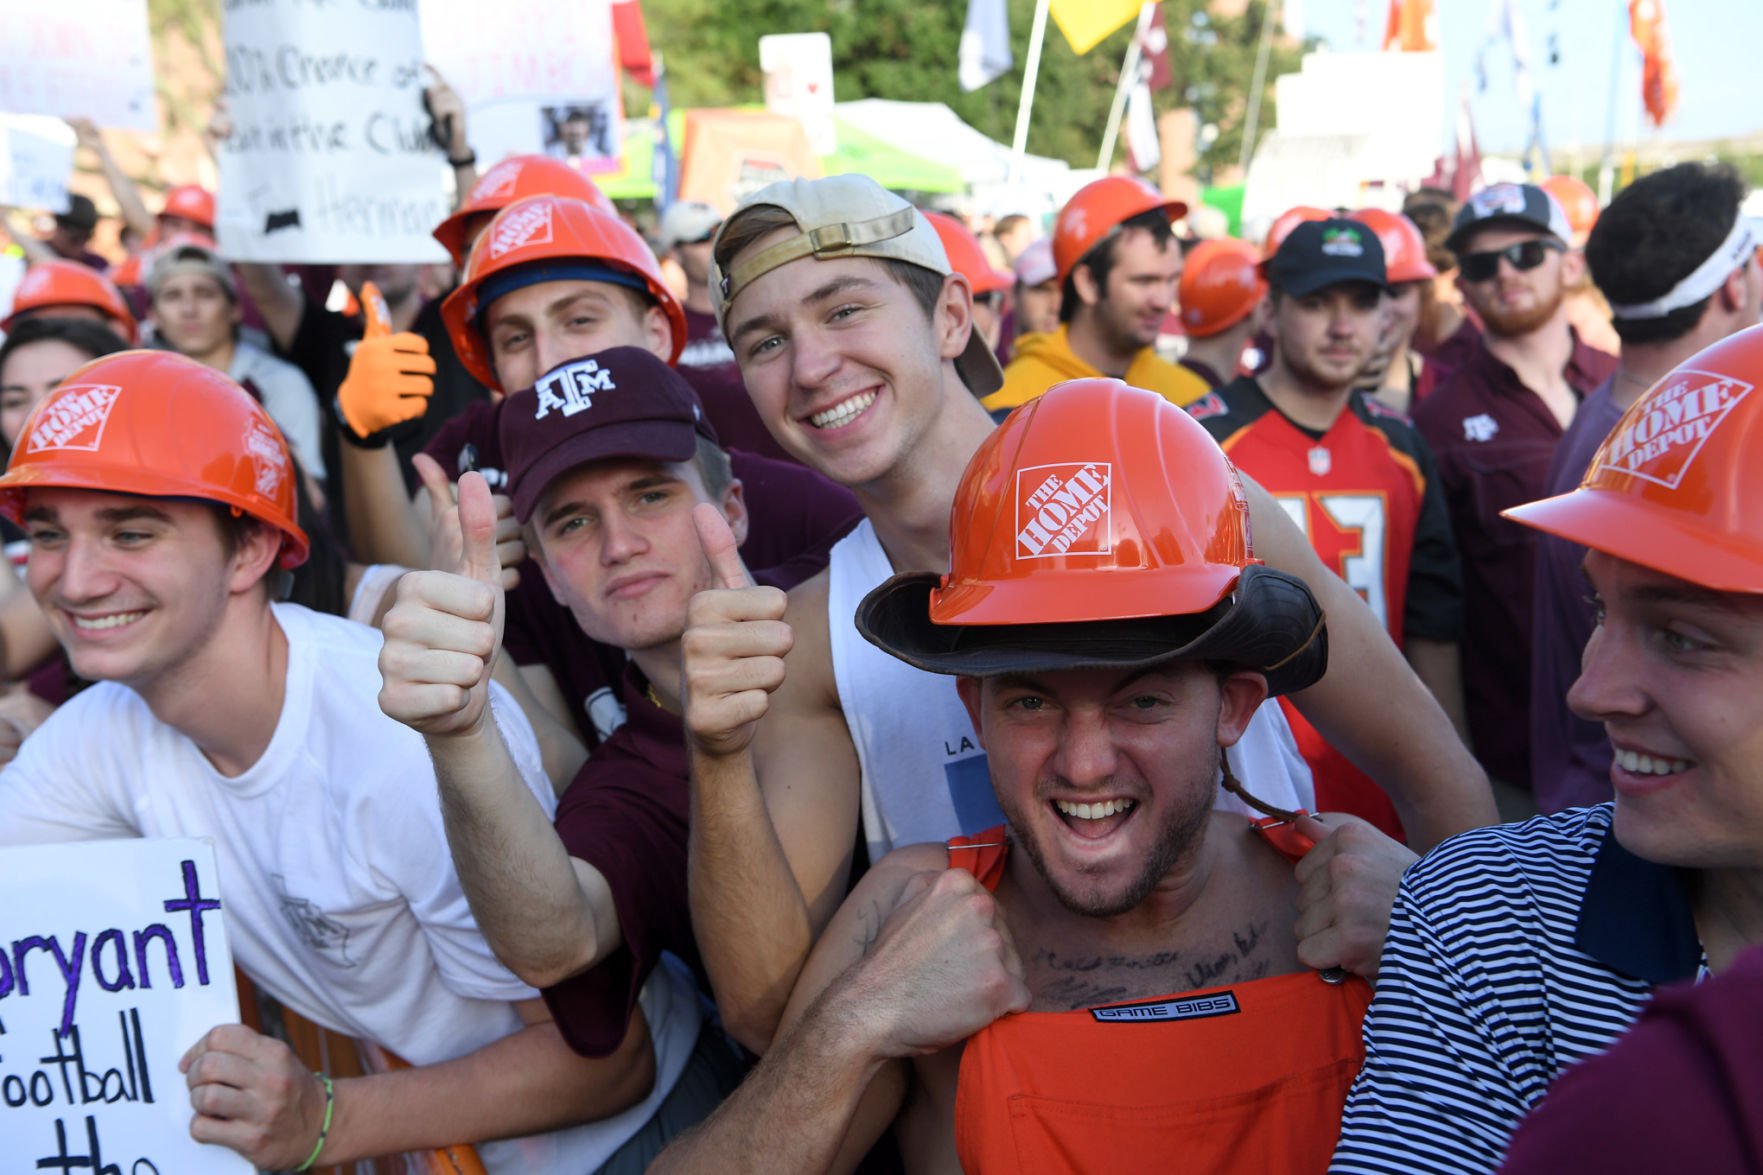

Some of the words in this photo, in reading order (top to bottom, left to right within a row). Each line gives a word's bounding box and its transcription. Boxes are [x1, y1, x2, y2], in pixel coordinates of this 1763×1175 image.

[31, 385, 117, 449] HOME
[1608, 380, 1738, 467] HOME
[1643, 381, 1689, 415] THE
[52, 406, 107, 448] DEPOT
[1627, 416, 1711, 470] DEPOT
[1018, 463, 1109, 557] HOME
[1025, 473, 1064, 511] THE
[1051, 494, 1109, 554] DEPOT
[1100, 1006, 1168, 1018] GAME
[1175, 997, 1232, 1014] BIBS
[0, 1007, 155, 1107] ootball
